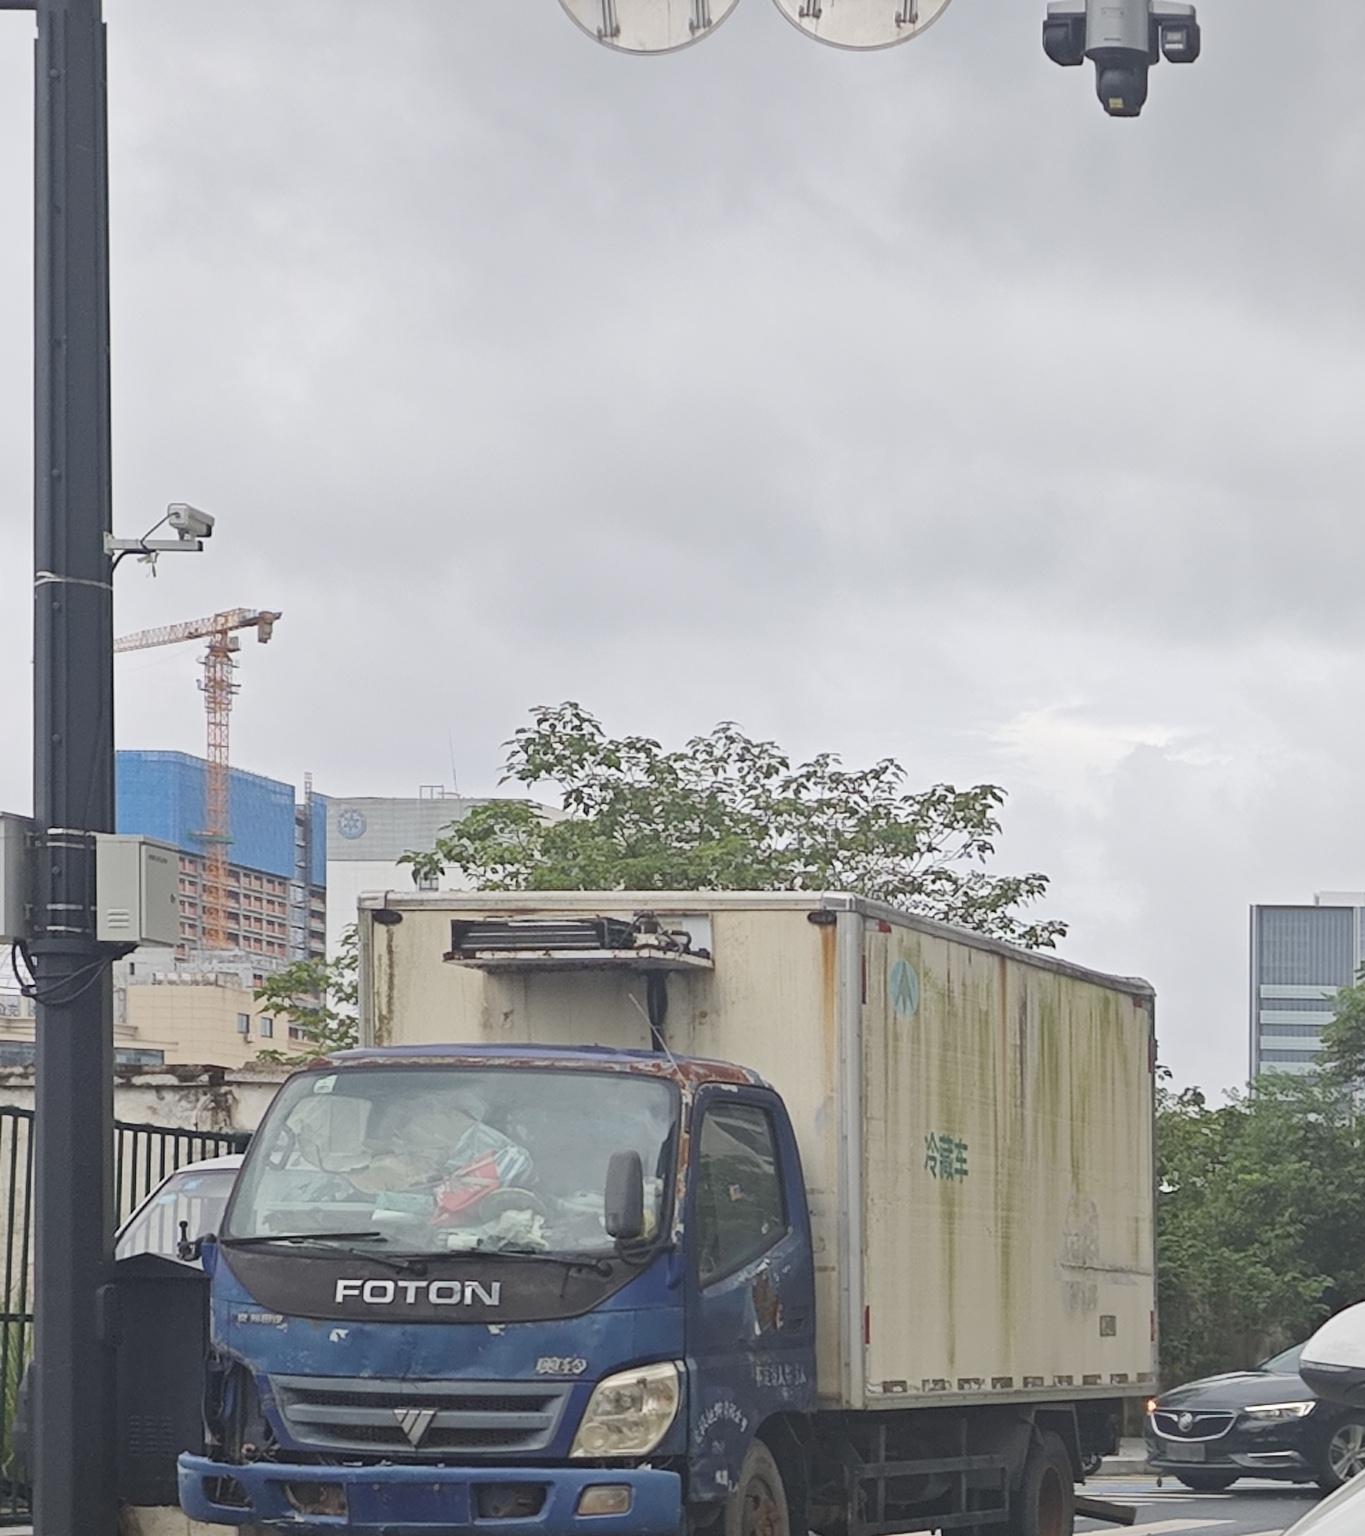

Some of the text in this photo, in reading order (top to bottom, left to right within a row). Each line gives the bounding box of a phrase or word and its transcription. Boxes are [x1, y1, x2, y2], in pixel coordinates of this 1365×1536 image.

[924, 1131, 969, 1185] 冷藏车
[334, 1278, 501, 1307] FOTON
